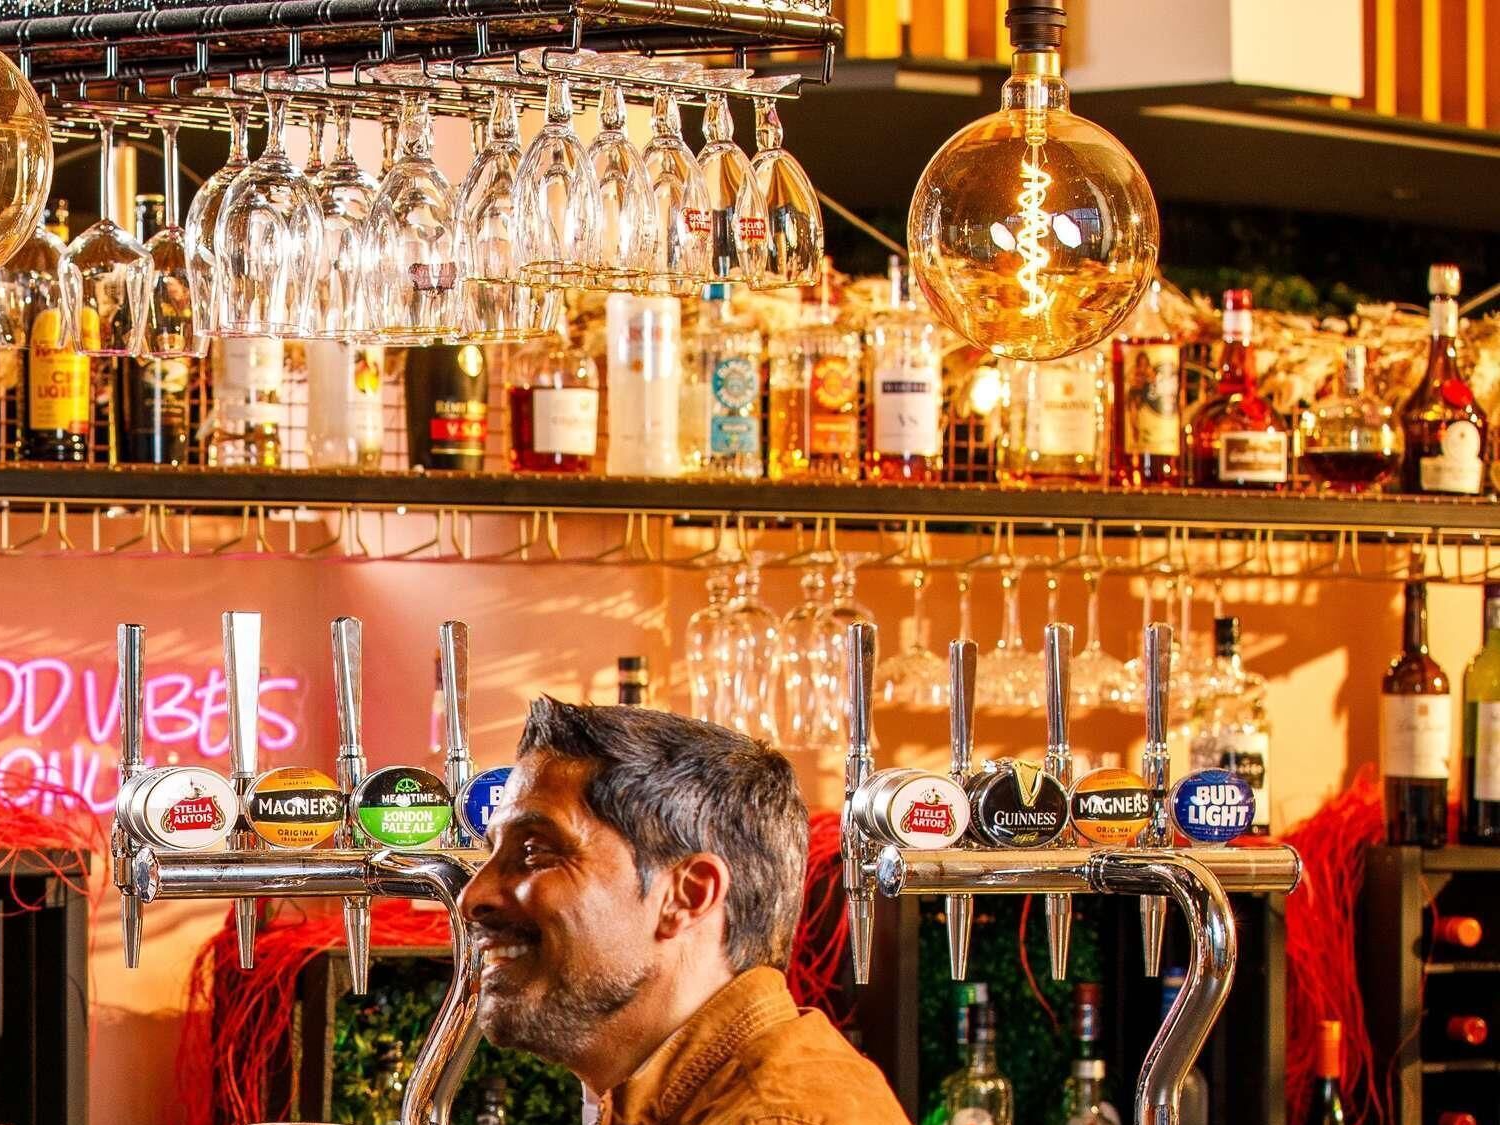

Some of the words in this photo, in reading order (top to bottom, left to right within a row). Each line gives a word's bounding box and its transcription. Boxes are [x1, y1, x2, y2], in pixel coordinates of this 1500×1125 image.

[84, 668, 299, 758] VBES
[382, 793, 435, 803] MEANTIME
[1195, 784, 1242, 805] BUD
[173, 803, 212, 814] STELLA
[258, 797, 337, 816] MAGNERS
[1080, 796, 1149, 814] MAGNERS
[173, 813, 213, 824] ARTOIS
[384, 811, 432, 822] LONDON
[913, 808, 947, 818] STELLA
[994, 810, 1057, 825] GUINNESS
[1188, 805, 1249, 827] LIGHT
[382, 822, 410, 833] PALE
[412, 822, 436, 833] ALE
[912, 818, 946, 829] ARTOIS
